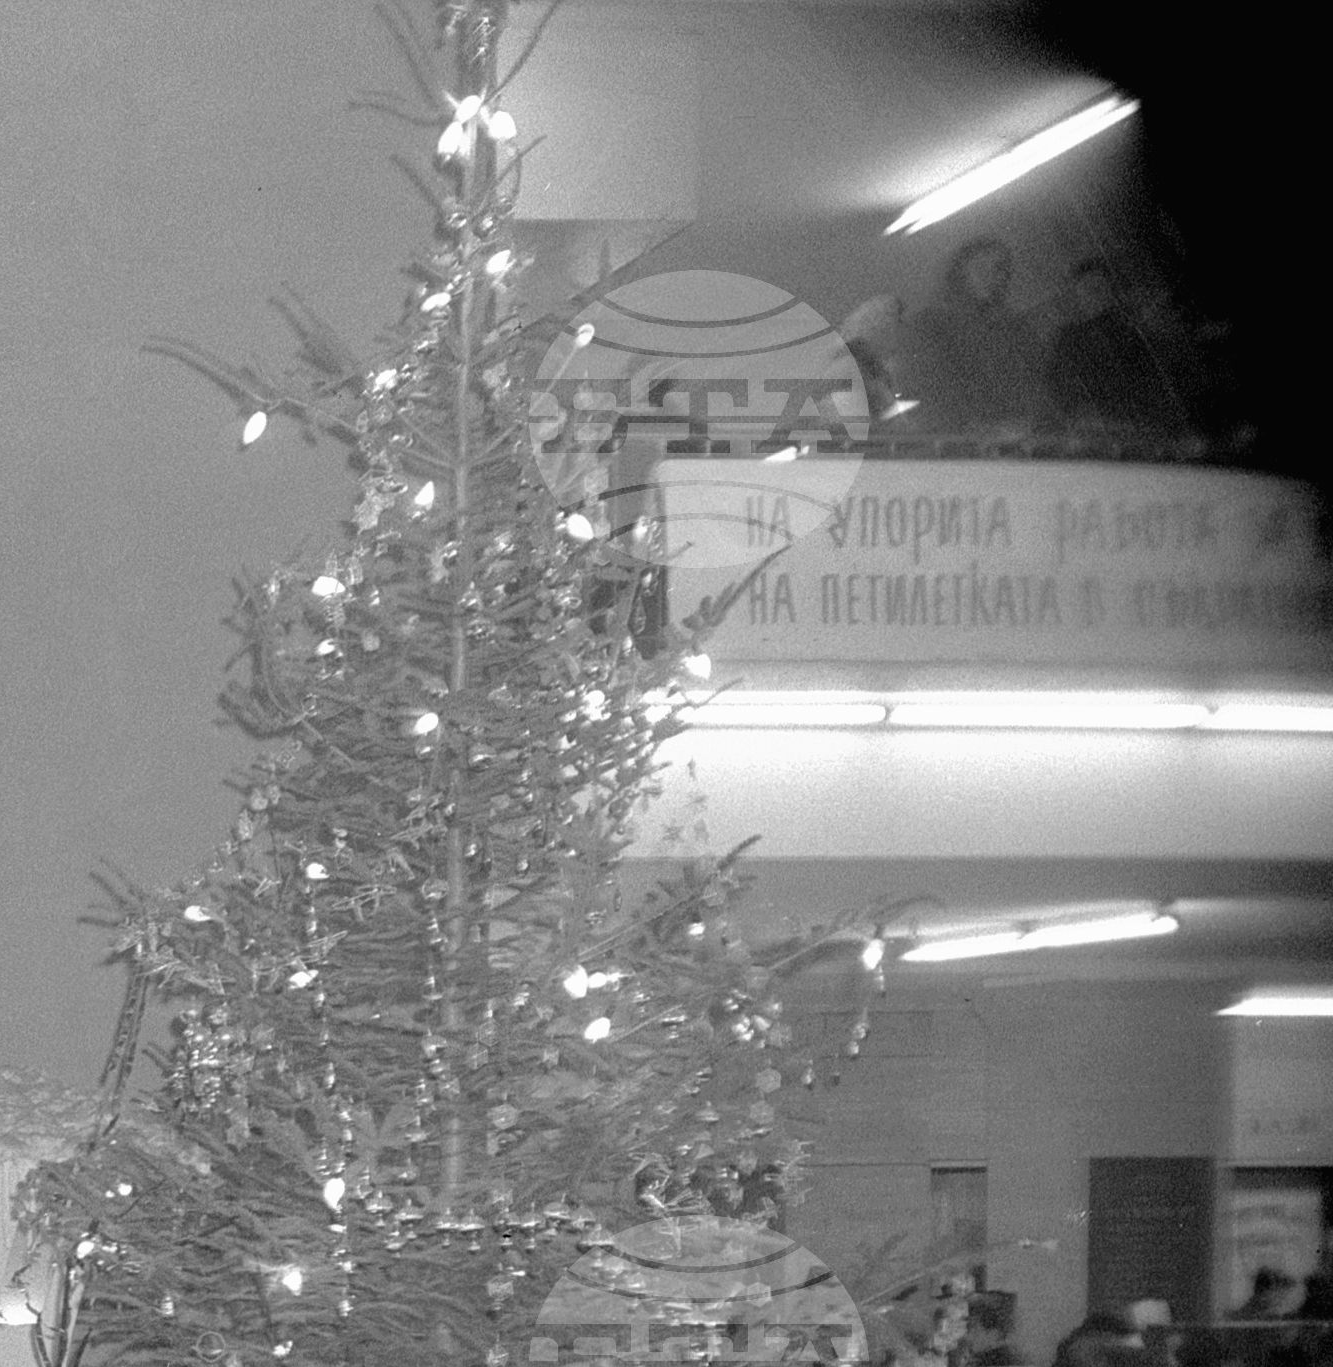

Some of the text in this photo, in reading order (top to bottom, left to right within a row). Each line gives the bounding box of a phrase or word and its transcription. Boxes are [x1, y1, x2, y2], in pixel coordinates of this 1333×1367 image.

[746, 496, 791, 546] НА
[828, 495, 1011, 563] УПОРИТА
[749, 573, 796, 625] НА
[821, 561, 1062, 626] ПЕТИЛЕТКАТА
